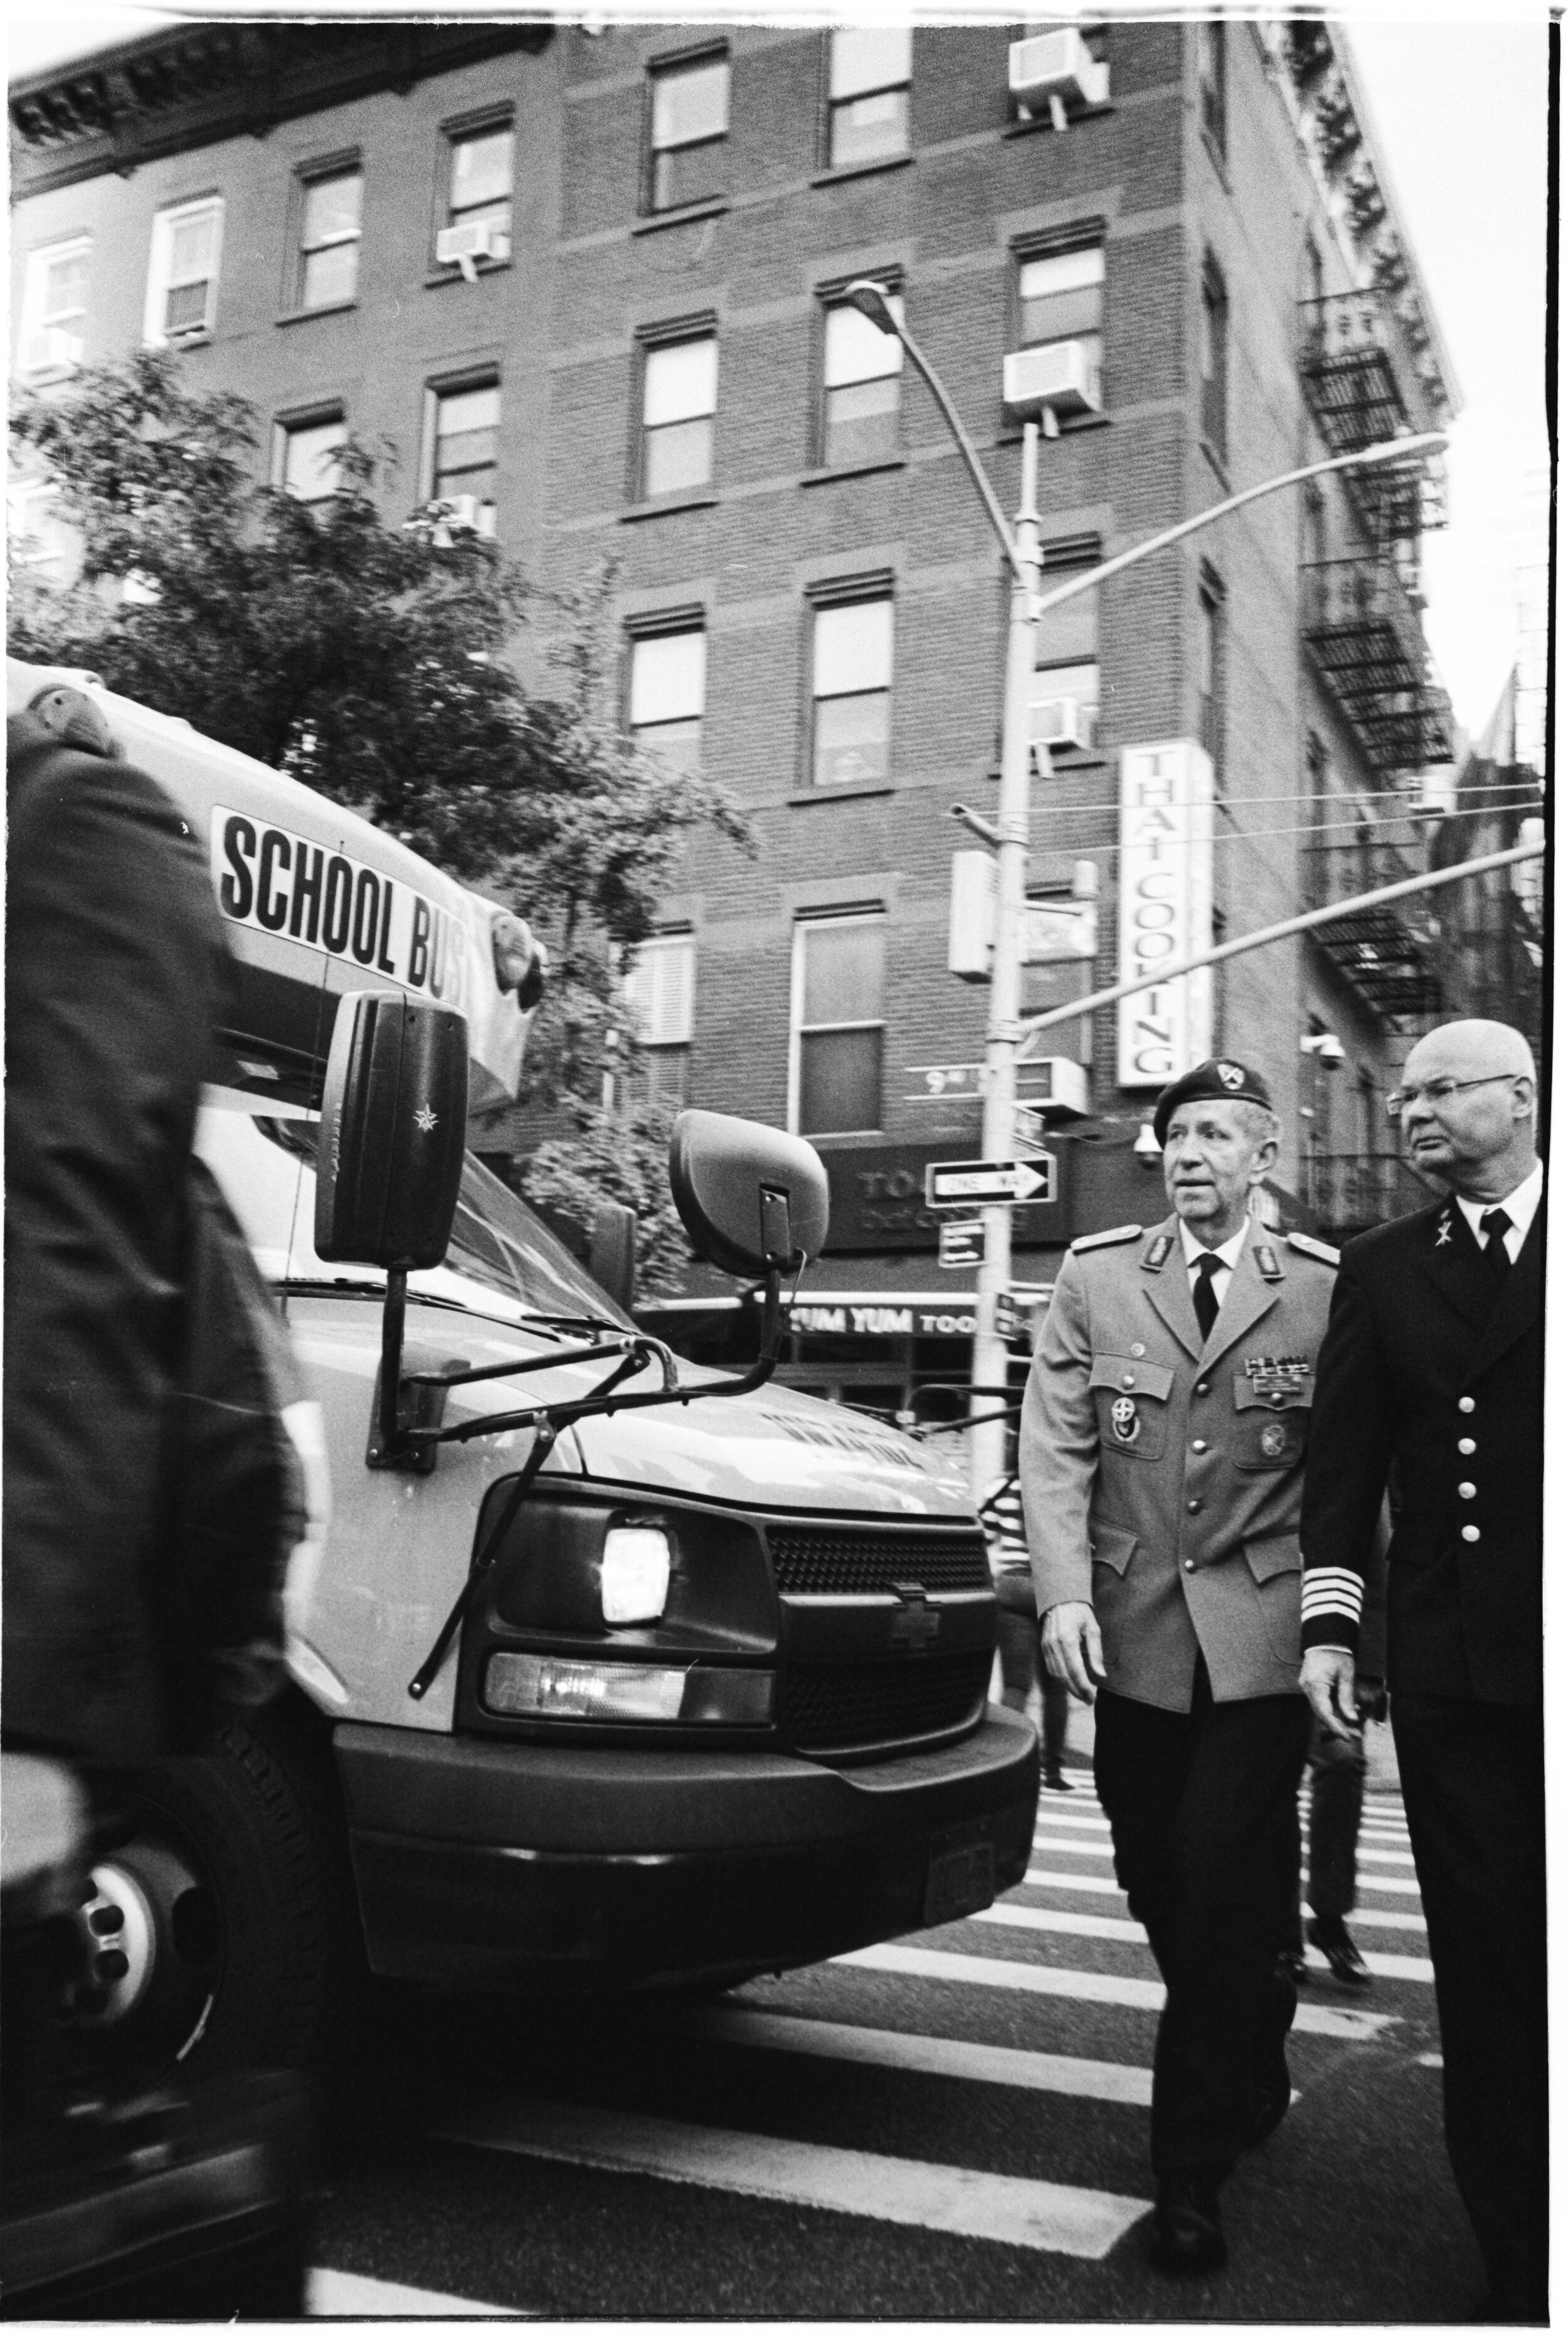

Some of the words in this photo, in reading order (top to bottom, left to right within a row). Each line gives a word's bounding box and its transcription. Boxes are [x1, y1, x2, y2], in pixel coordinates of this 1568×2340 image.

[1135, 750, 1177, 860] THAI
[220, 816, 395, 975] SCHOOL
[849, 1307, 914, 1334] YUM
